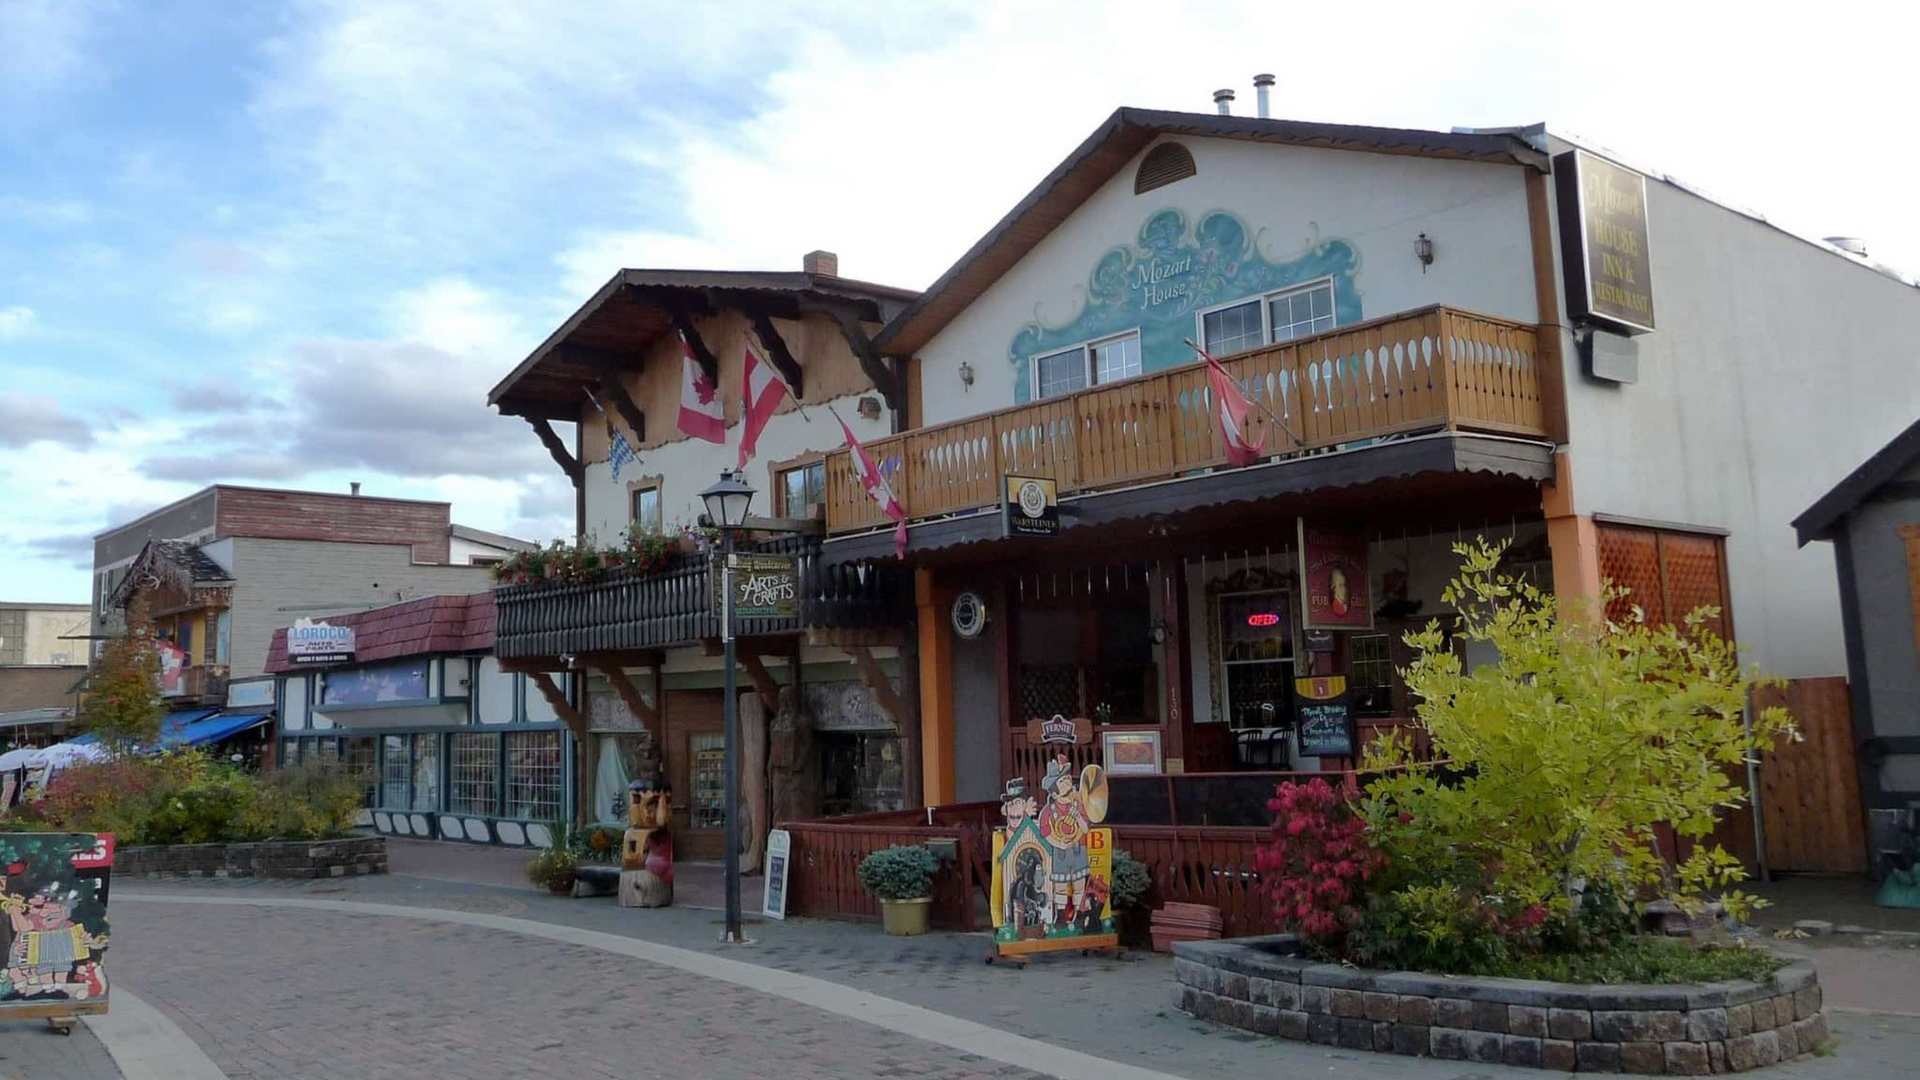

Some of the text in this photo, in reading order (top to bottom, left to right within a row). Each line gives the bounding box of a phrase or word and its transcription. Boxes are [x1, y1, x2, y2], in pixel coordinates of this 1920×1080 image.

[1586, 173, 1639, 216] Mozart
[1594, 218, 1639, 257] HOUSE
[1132, 254, 1191, 289] Mozart
[1602, 253, 1636, 284] INN &
[1140, 283, 1186, 310] House
[1595, 281, 1648, 313] RESTAURANT
[753, 583, 794, 606] CRAFTS
[1312, 595, 1329, 606] PUB
[294, 627, 346, 640] LORDCO
[1248, 614, 1279, 626] OPEN
[1045, 723, 1073, 733] FERNIE
